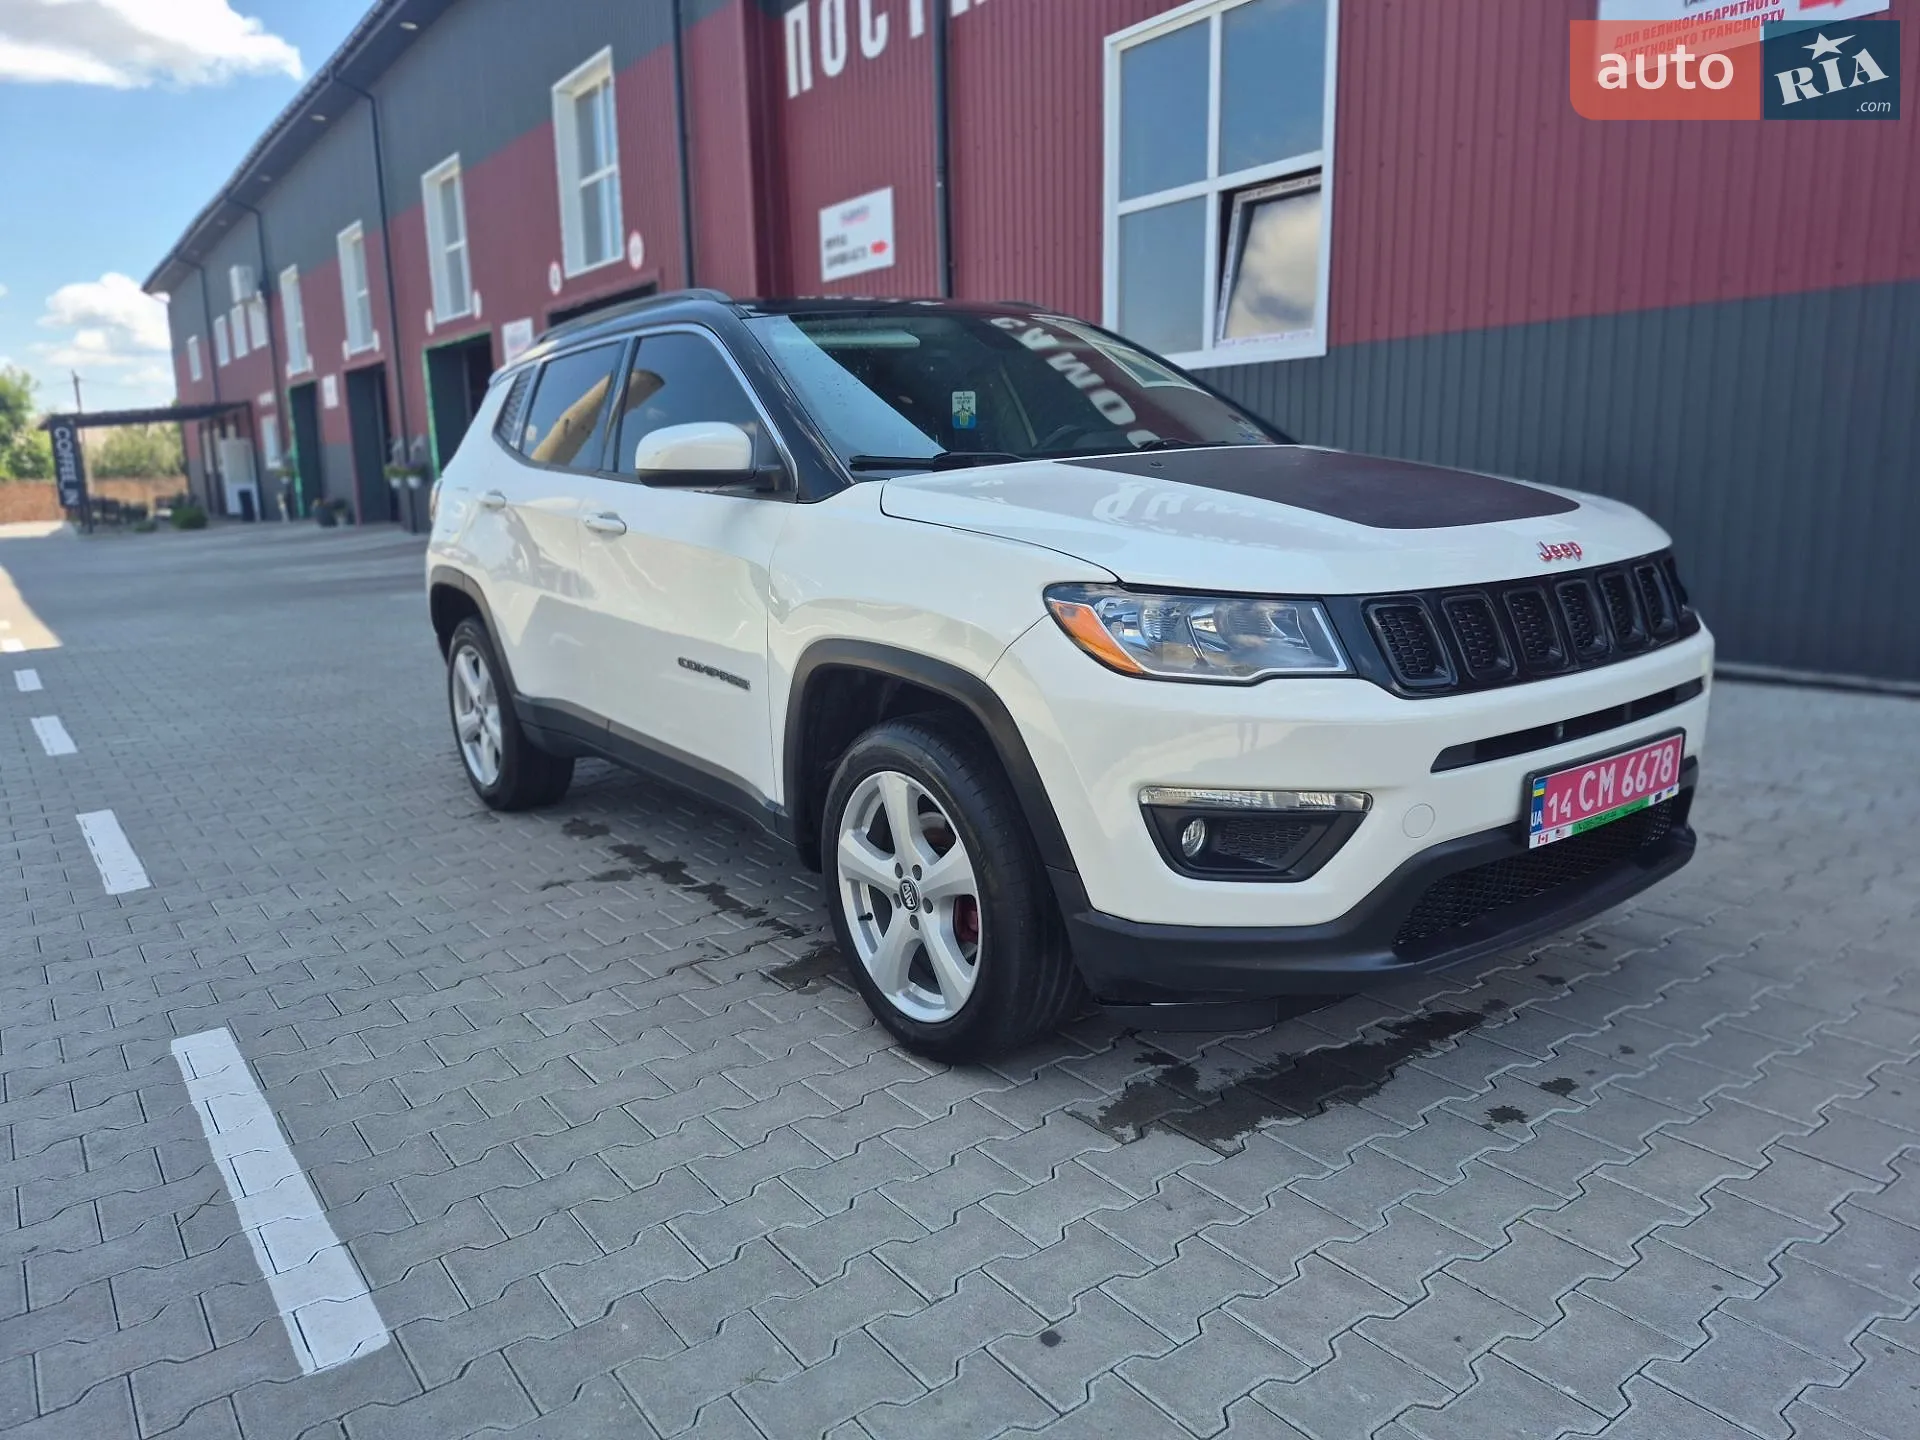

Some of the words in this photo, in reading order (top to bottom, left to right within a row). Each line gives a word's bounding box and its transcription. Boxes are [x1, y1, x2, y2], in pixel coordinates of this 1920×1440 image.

[1537, 540, 1583, 562] Jeep
[1548, 788, 1573, 822] 14
[1578, 762, 1616, 812] CM
[1621, 745, 1674, 798] 6678
[1531, 812, 1543, 826] UA
